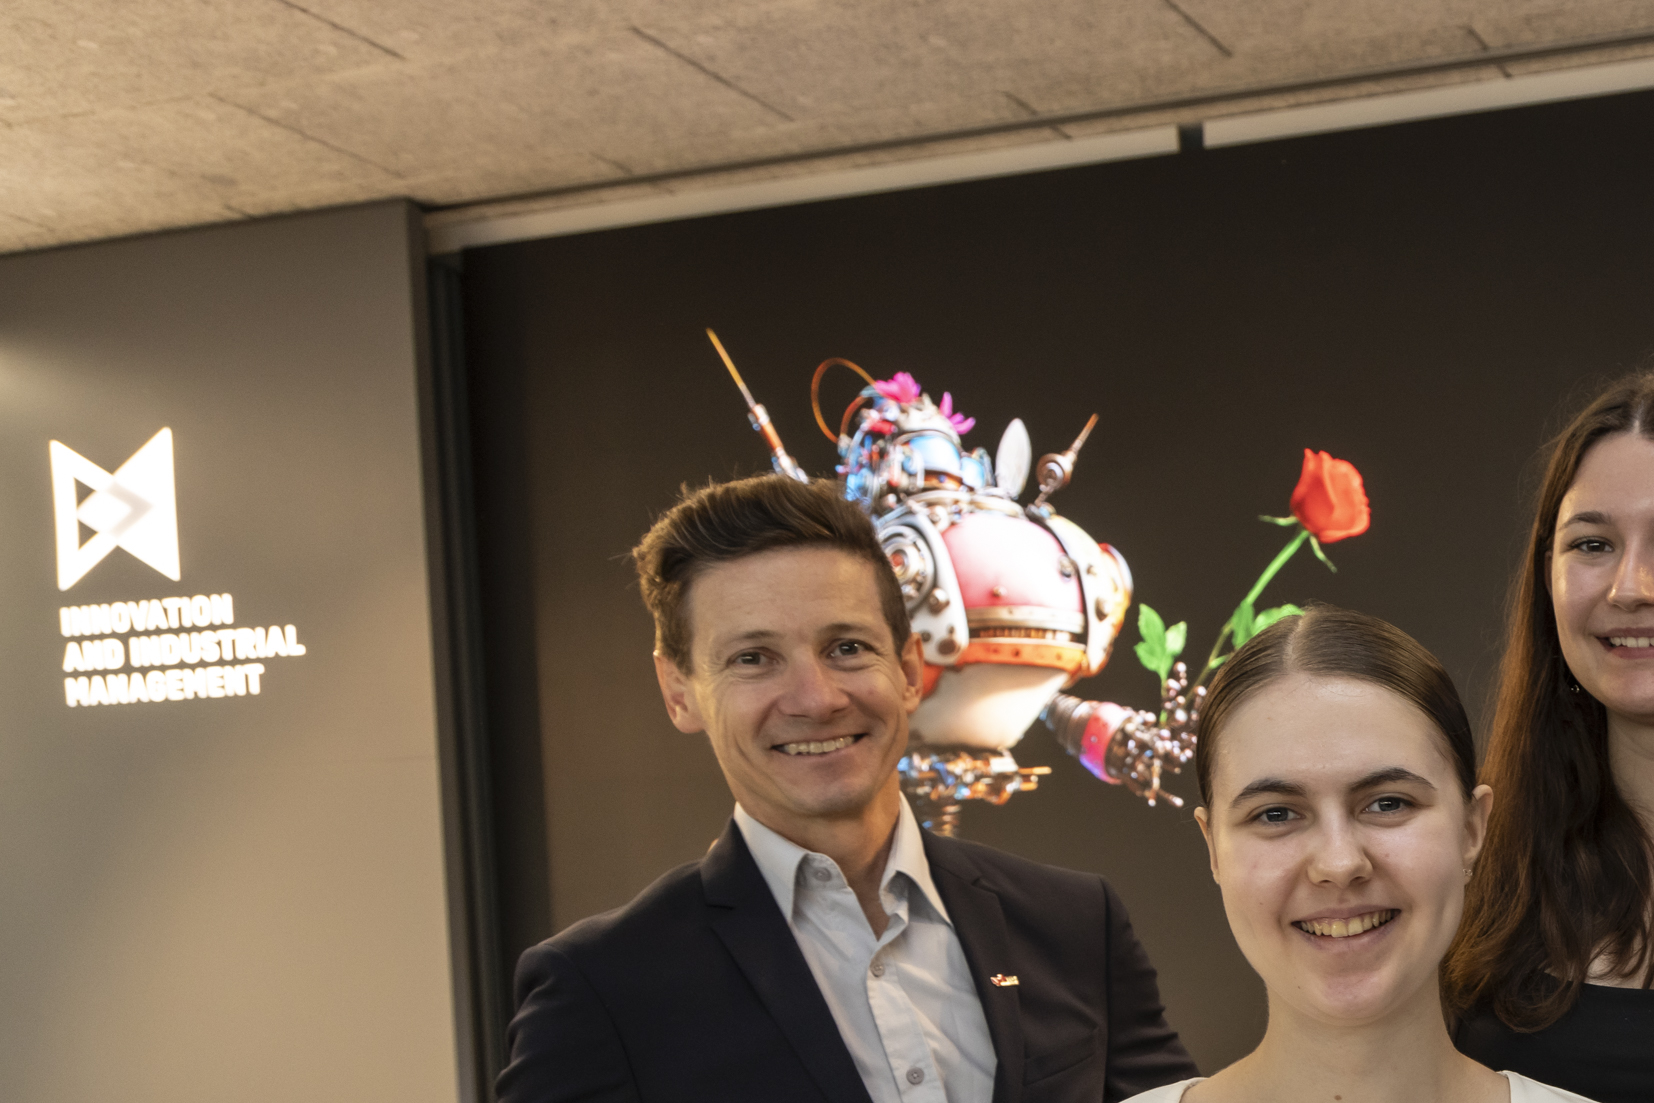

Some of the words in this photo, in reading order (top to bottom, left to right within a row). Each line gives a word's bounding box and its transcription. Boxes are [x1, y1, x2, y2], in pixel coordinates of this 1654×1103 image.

[60, 593, 234, 637] INNOVATION
[63, 637, 126, 673] AND
[129, 624, 306, 668] INDUSTRIAL
[64, 663, 265, 708] MANAGEMENT
